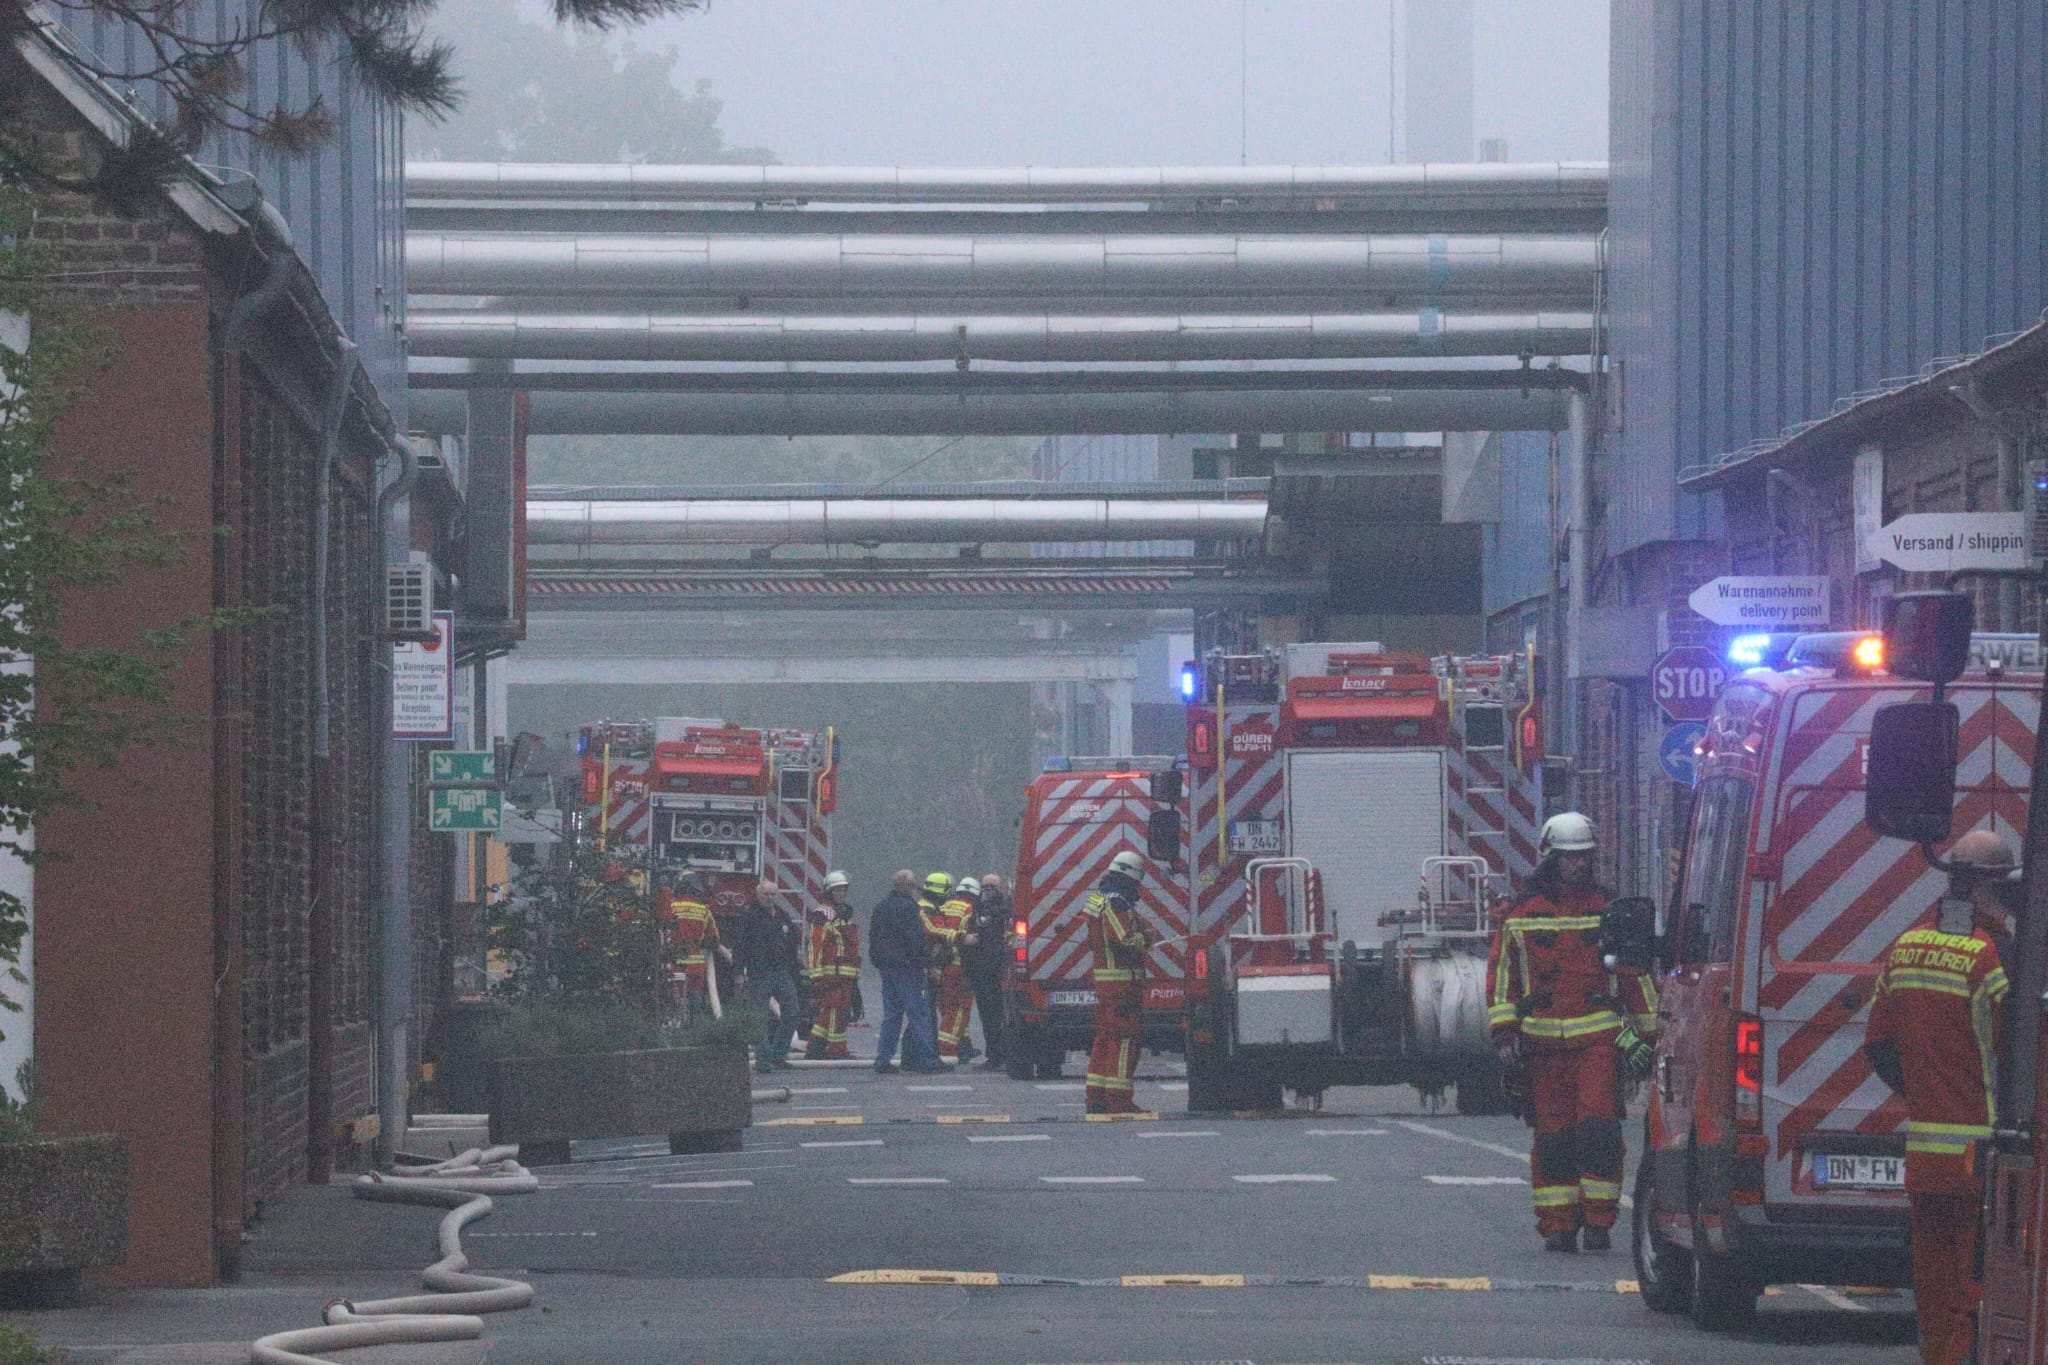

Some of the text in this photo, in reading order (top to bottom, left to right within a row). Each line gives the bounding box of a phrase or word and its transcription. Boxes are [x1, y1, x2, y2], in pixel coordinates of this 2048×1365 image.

[1893, 532, 2023, 553] Versand / shippin
[1718, 583, 1814, 598] Warenannahme
[1740, 604, 1822, 620] delivery point
[1659, 667, 1724, 698] STOP
[1233, 732, 1272, 744] DÜREN
[1924, 948, 1977, 974] DÜREN
[1830, 1159, 1855, 1180] DN
[1871, 1160, 1898, 1181] FW
